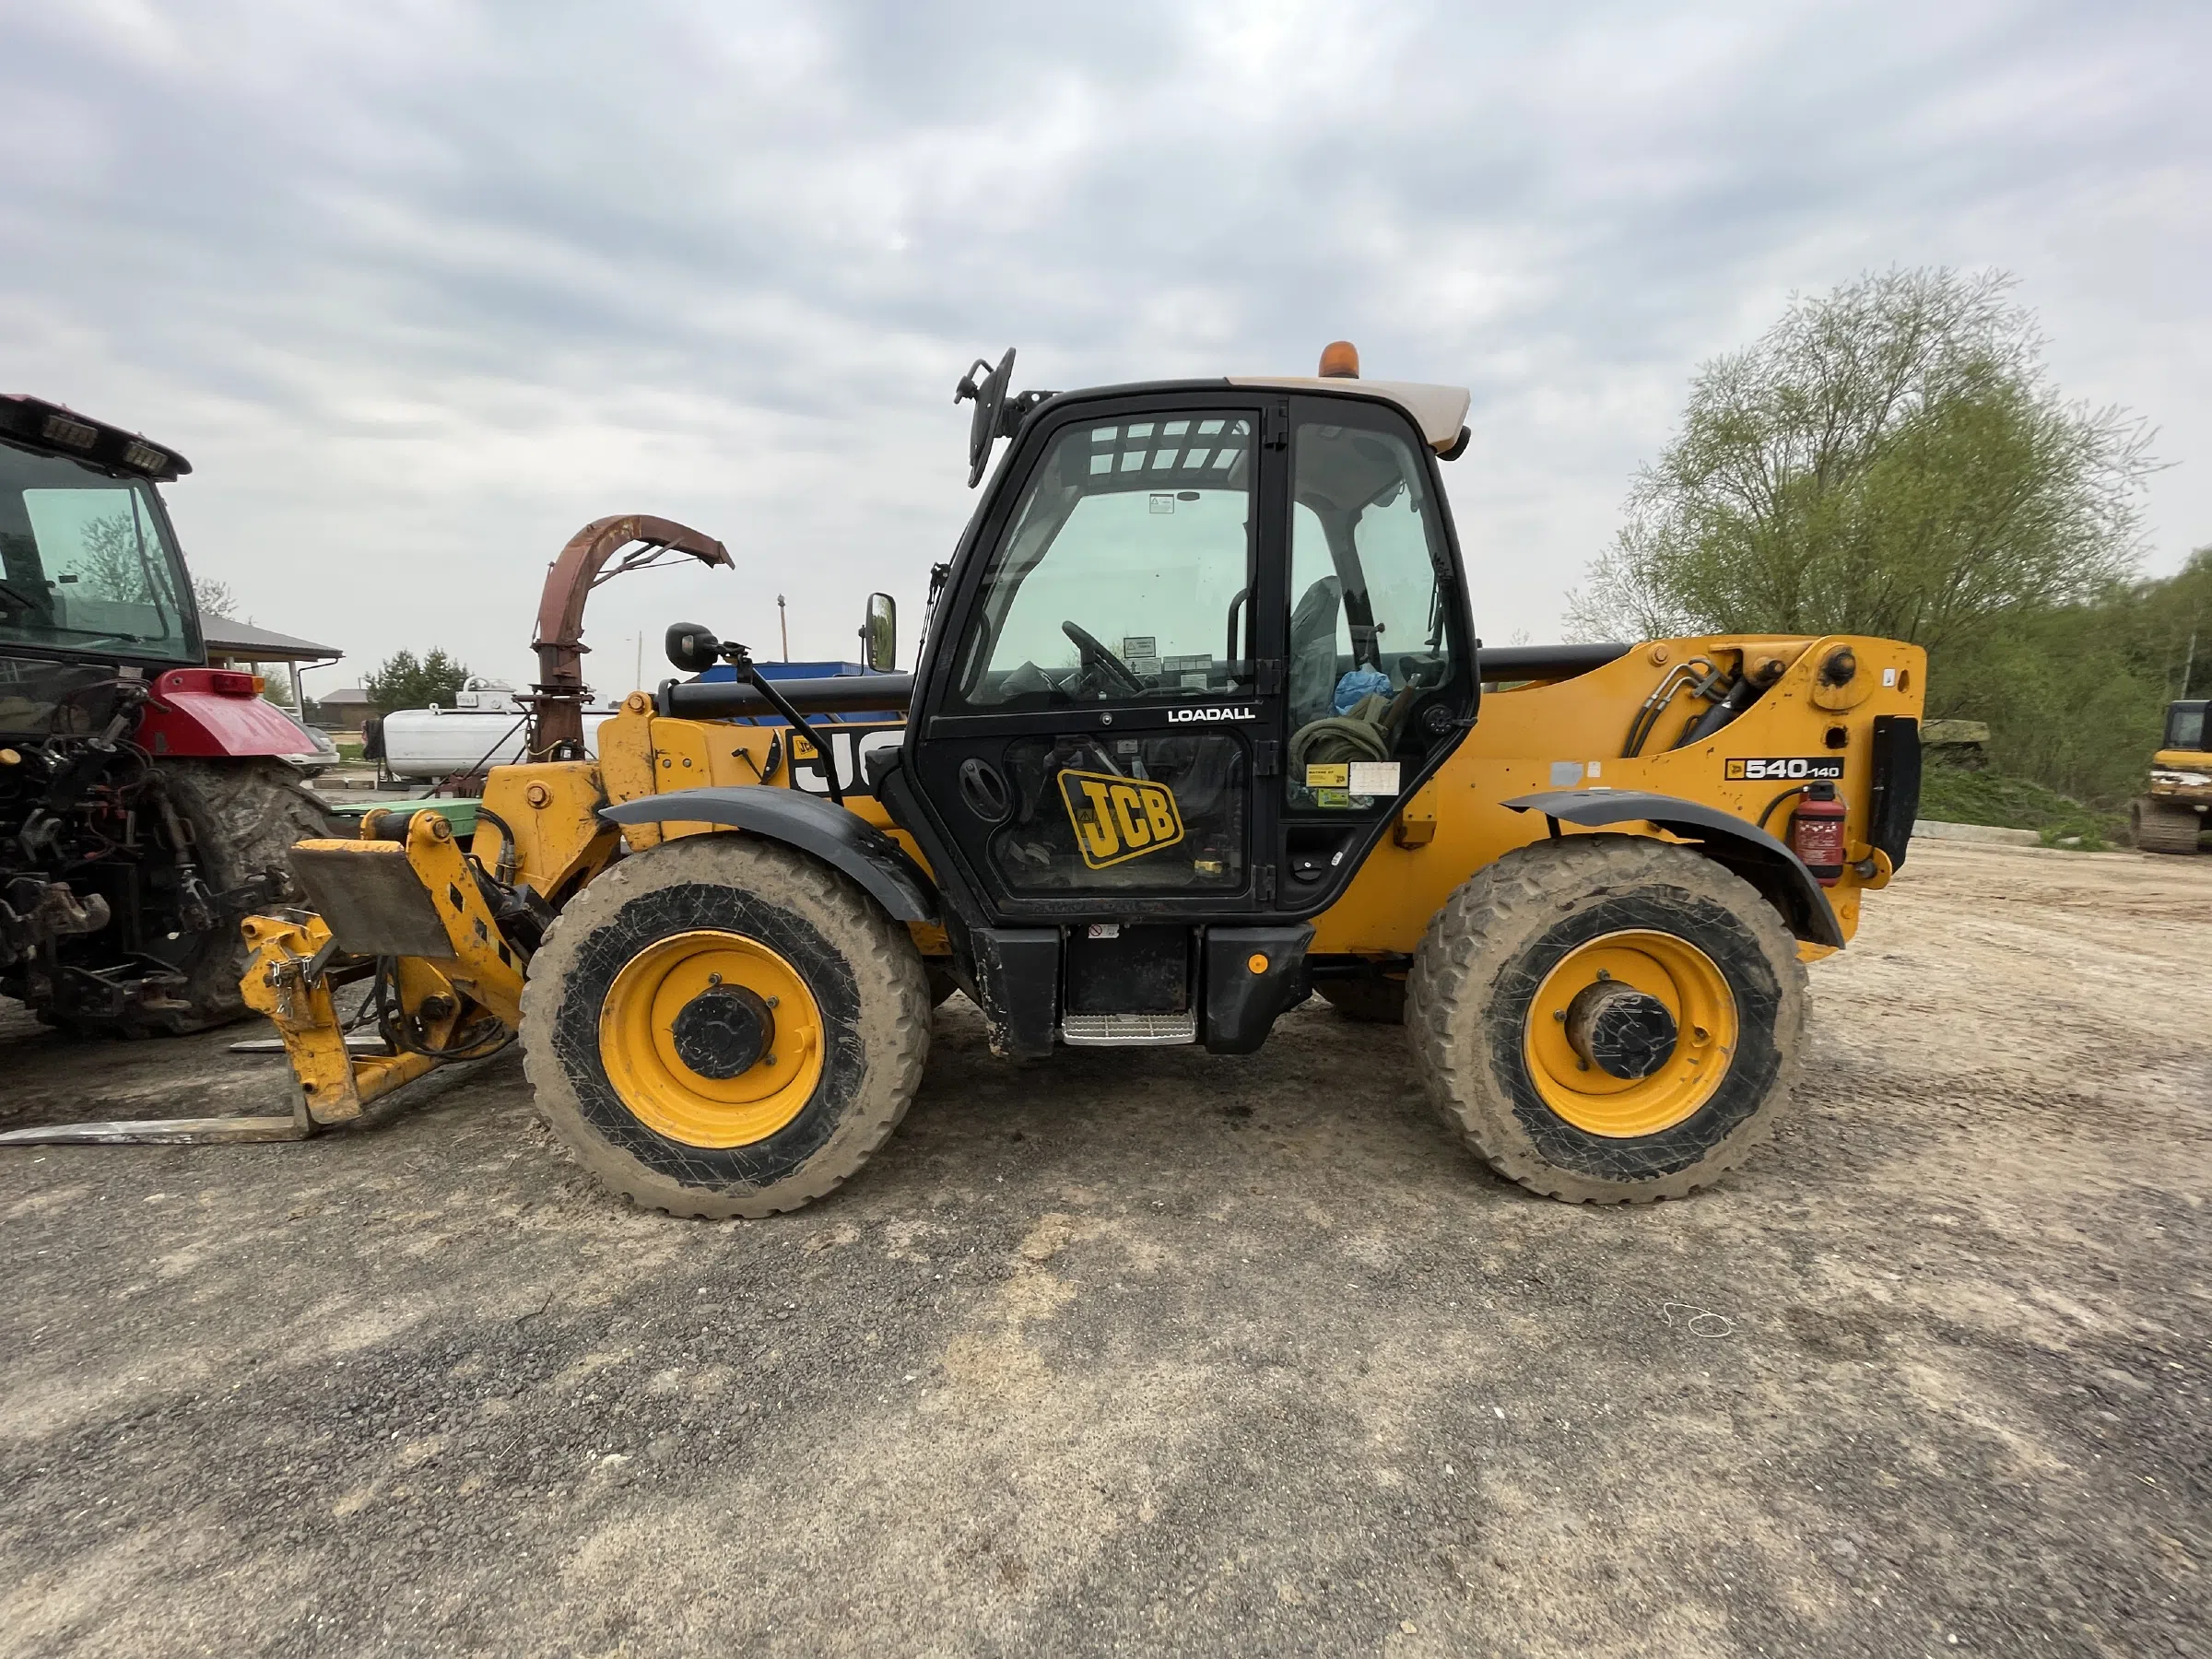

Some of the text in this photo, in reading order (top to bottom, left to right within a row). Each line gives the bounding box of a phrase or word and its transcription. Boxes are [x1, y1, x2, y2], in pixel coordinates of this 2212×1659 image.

[1168, 707, 1256, 723] LOADALL
[1745, 759, 1840, 779] 540-140
[1080, 780, 1176, 858] JCB
